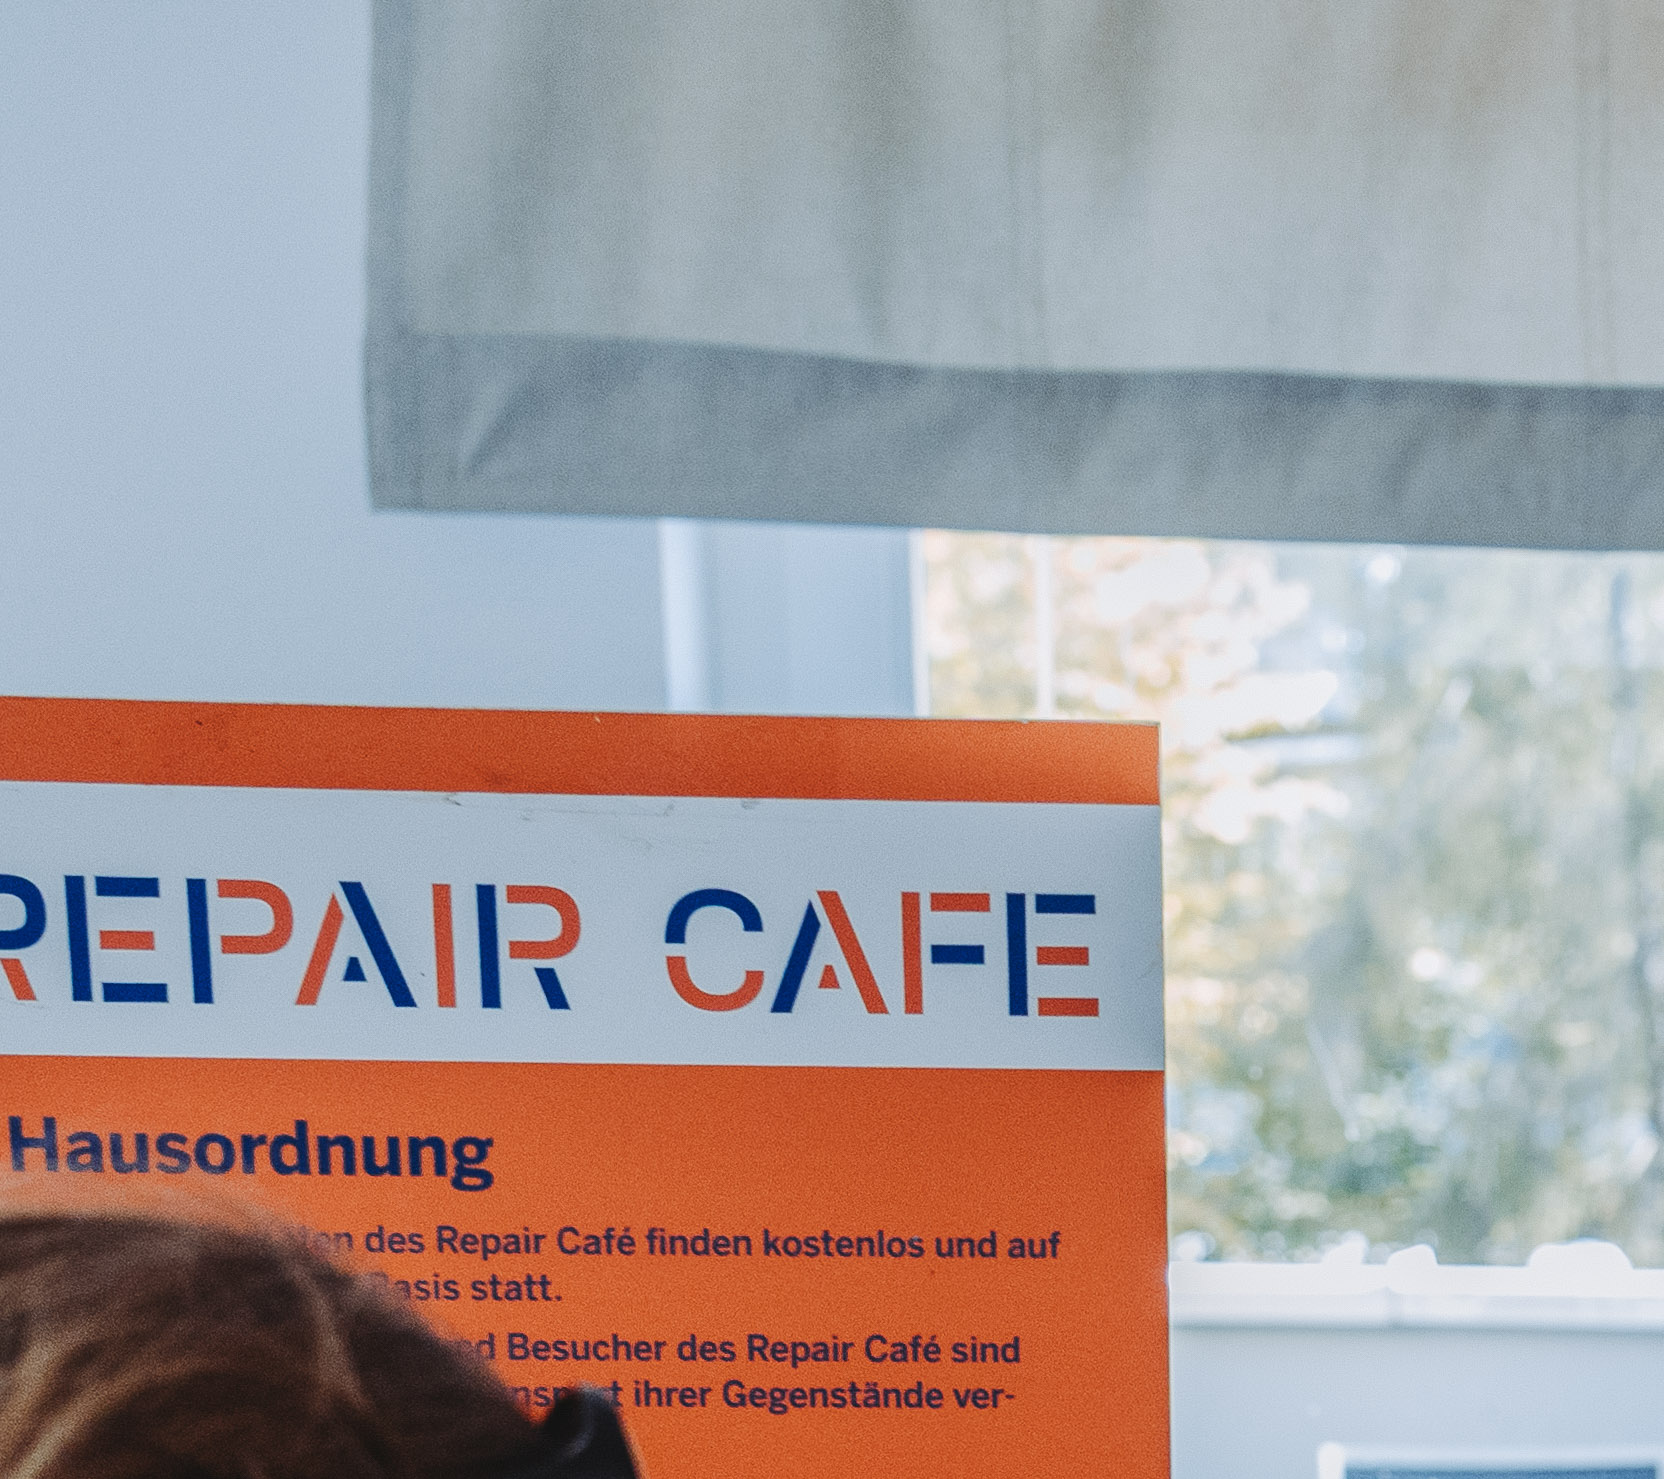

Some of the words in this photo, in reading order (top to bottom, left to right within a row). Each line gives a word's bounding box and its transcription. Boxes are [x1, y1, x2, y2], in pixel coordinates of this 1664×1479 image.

[663, 887, 1101, 1017] CAFE
[6, 1114, 495, 1192] Hausordnung
[364, 1225, 425, 1254] des
[436, 1224, 546, 1261] Repair
[557, 1226, 636, 1256] Café
[645, 1227, 752, 1257] finden
[763, 1228, 925, 1259] kostenlos
[935, 1230, 997, 1258] und
[1007, 1231, 1060, 1259] auf
[470, 1274, 561, 1302] statt.
[507, 1332, 666, 1362] Besucher
[677, 1334, 737, 1362] des
[747, 1333, 854, 1369] Repair
[864, 1334, 941, 1363] Café
[951, 1336, 1020, 1364] sind
[634, 1380, 712, 1408] ihrer
[722, 1379, 944, 1416] Gegenstände
[953, 1387, 1014, 1410] ver-
